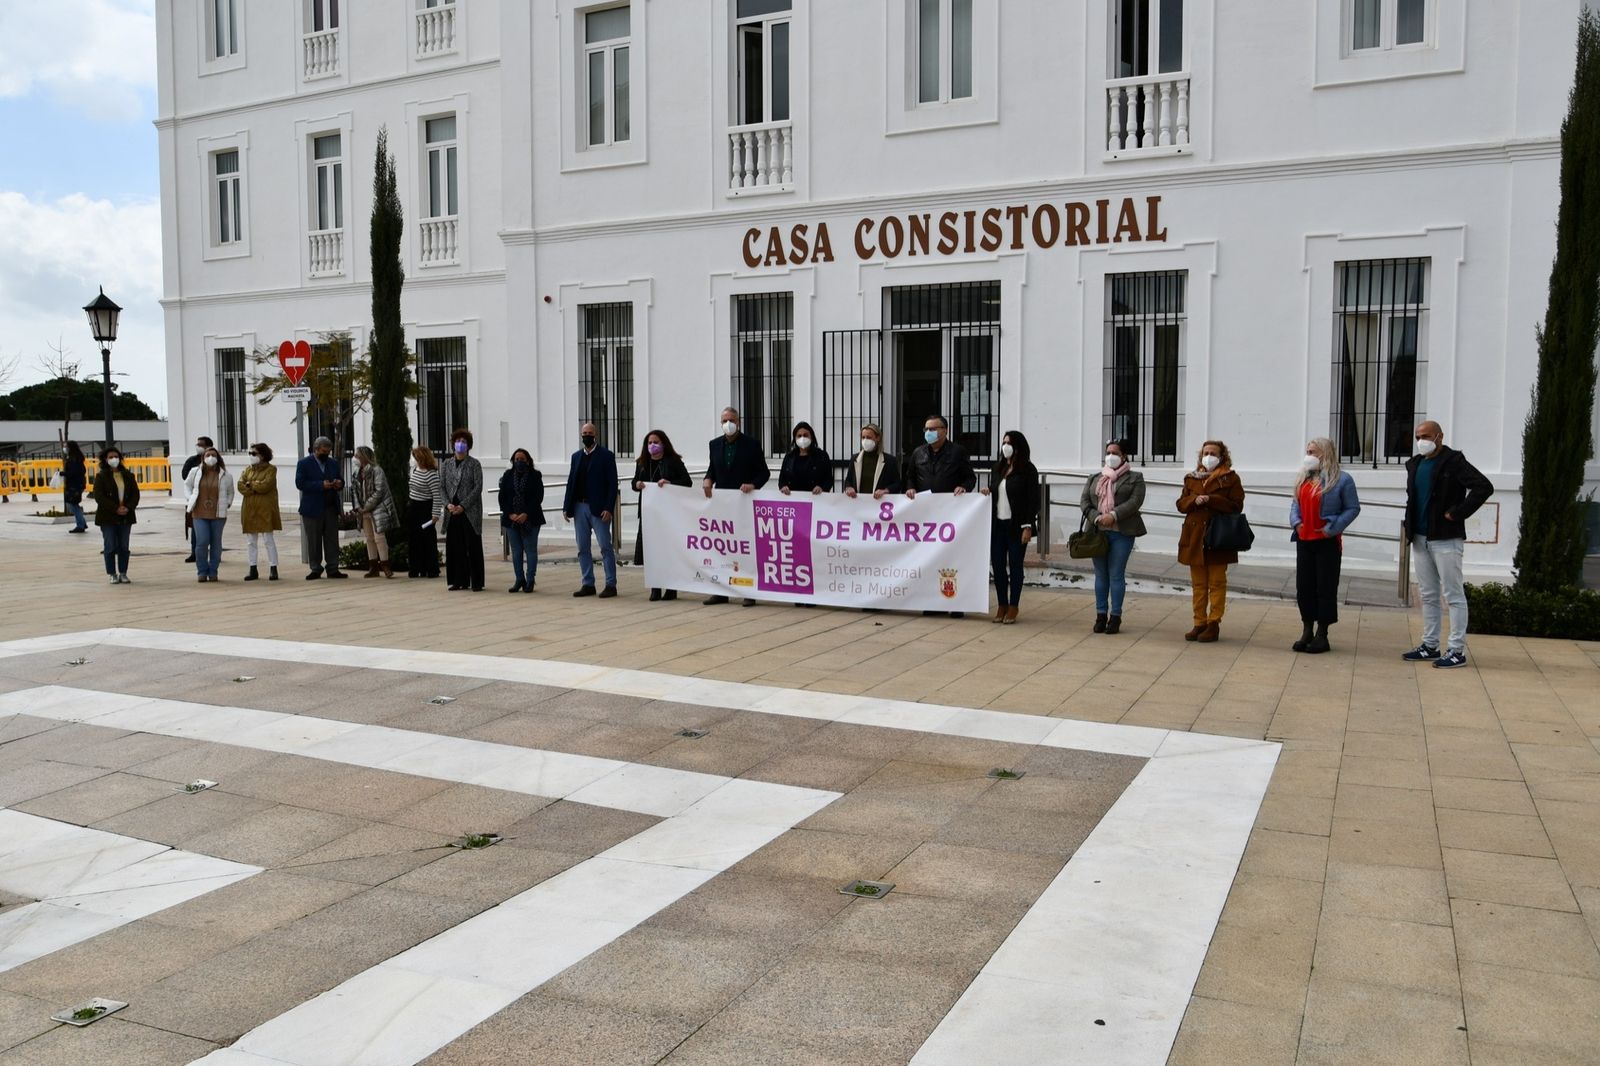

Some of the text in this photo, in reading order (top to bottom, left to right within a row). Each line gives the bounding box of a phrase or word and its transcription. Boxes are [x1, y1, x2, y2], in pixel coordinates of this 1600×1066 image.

[742, 195, 1168, 268] CASA CONSISTORIAL
[755, 507, 796, 517] POR SER
[878, 501, 895, 522] 8
[698, 517, 735, 535] SAN
[757, 516, 794, 541] MU
[815, 520, 956, 543] DE MARZO
[686, 535, 751, 556] ROQUE
[767, 540, 795, 563] JE
[826, 545, 850, 558] Día
[763, 561, 811, 587] RES
[828, 563, 921, 579] Internacional
[828, 580, 909, 598] de la Mujer
